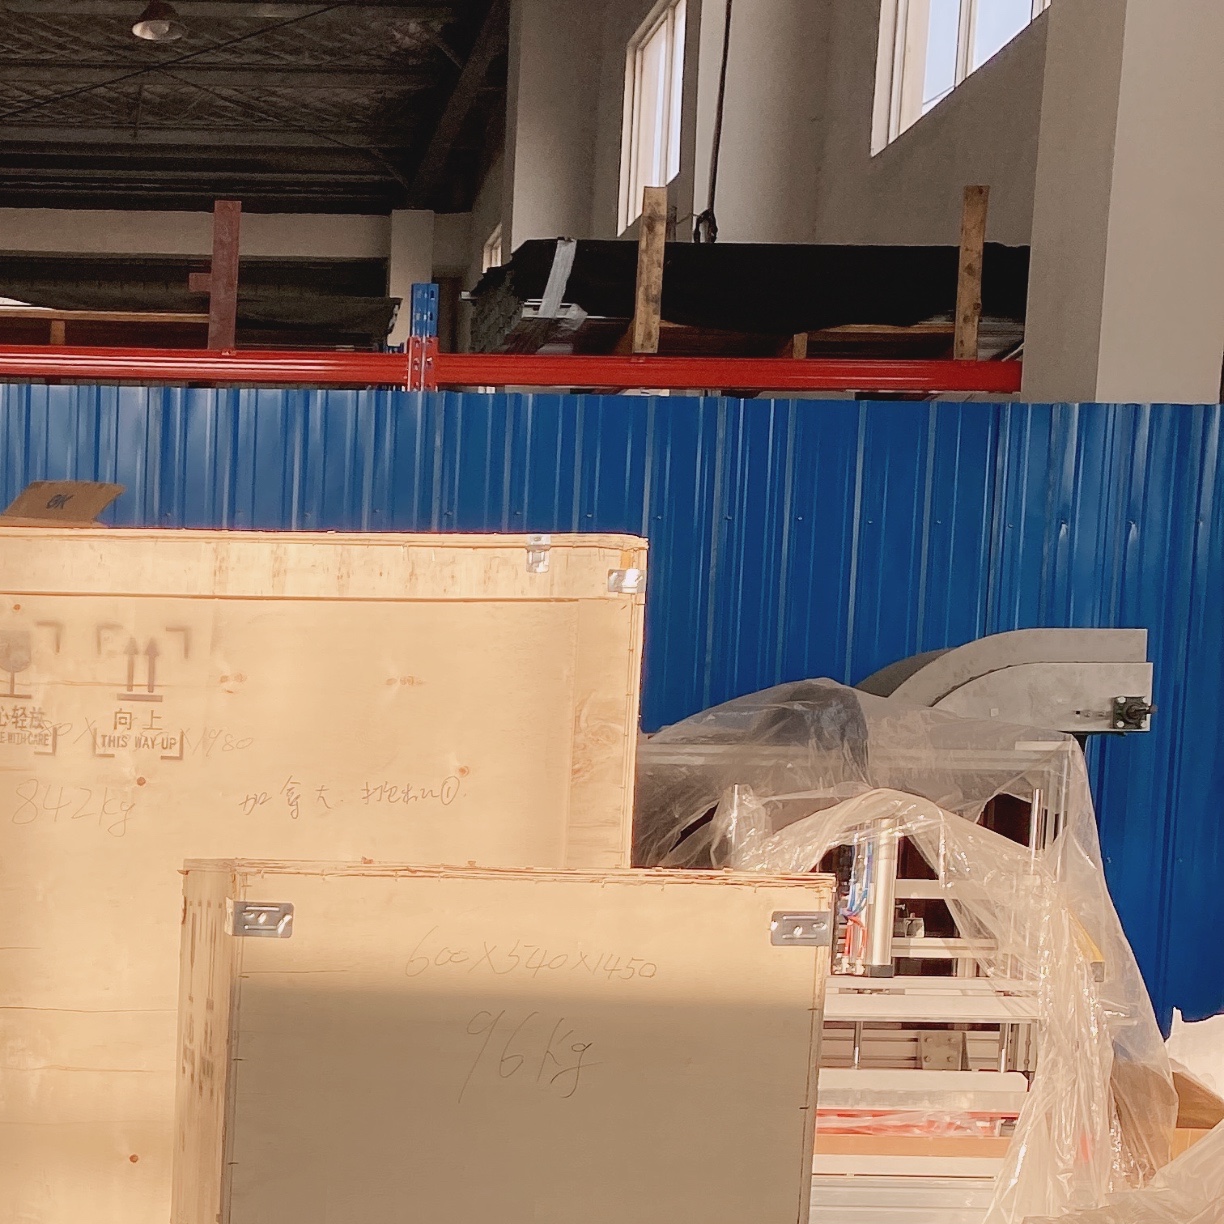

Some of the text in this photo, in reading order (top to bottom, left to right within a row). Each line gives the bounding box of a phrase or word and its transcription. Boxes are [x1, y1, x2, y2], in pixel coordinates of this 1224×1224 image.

[113, 708, 163, 731] 向上
[7, 732, 26, 745] WITH
[27, 733, 50, 746] CARE
[101, 734, 177, 750] THIS WAY UP
